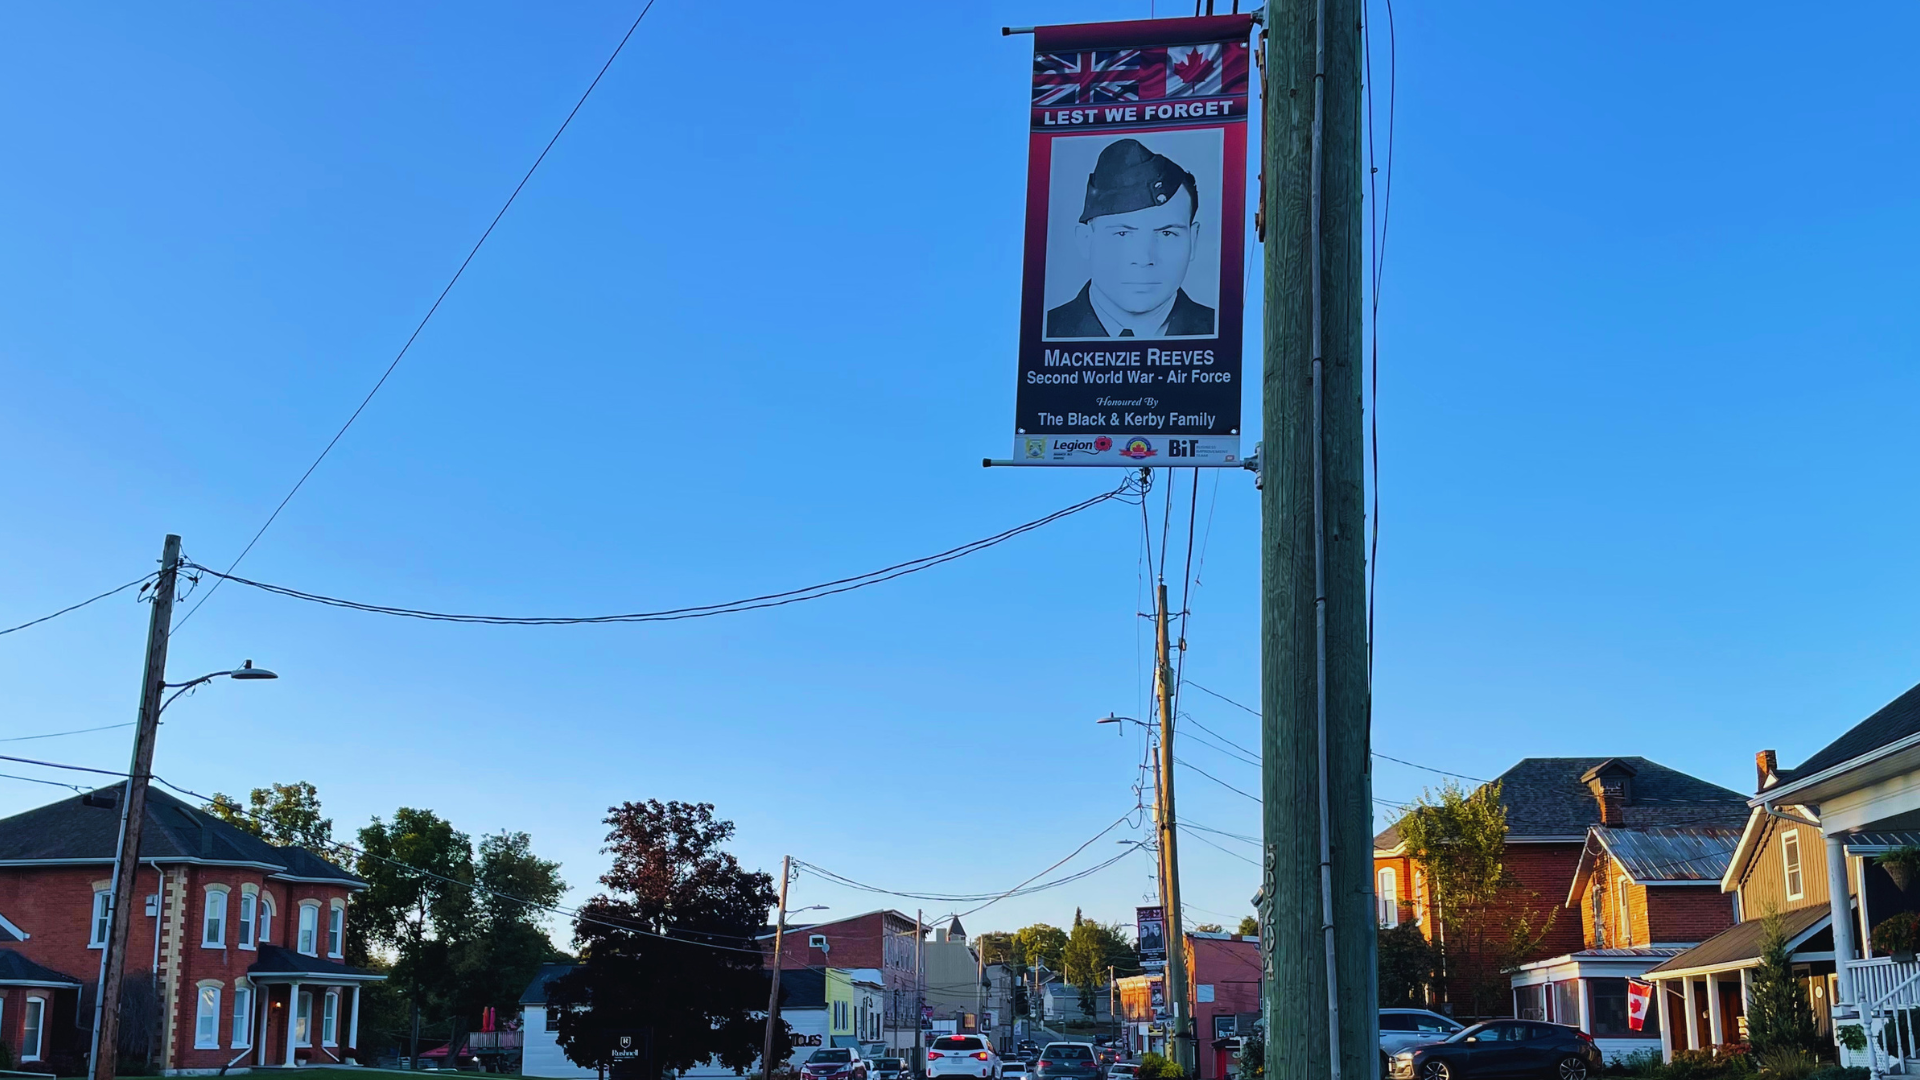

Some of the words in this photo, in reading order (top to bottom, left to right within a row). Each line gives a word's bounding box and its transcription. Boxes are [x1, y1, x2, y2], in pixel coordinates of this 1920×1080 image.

[1044, 109, 1098, 125] LEST
[1105, 107, 1137, 122] WE
[1145, 101, 1233, 120] FORGET
[1147, 348, 1214, 366] REEVES
[1027, 371, 1078, 384] Second
[1082, 370, 1123, 384] World
[1127, 370, 1155, 383] War
[1167, 370, 1187, 383] Air
[1191, 369, 1231, 383] Force
[1095, 396, 1142, 407] Honoured
[1143, 397, 1159, 409] By
[1038, 412, 1063, 426] The
[1067, 412, 1106, 426] Black
[1110, 412, 1120, 426] &
[1124, 412, 1165, 429] Kerby
[1169, 412, 1216, 429] Family
[1053, 439, 1093, 452] Legion
[1169, 439, 1199, 457] BiT
[1265, 844, 1277, 981] 50204
[789, 1033, 822, 1047] TIQUES
